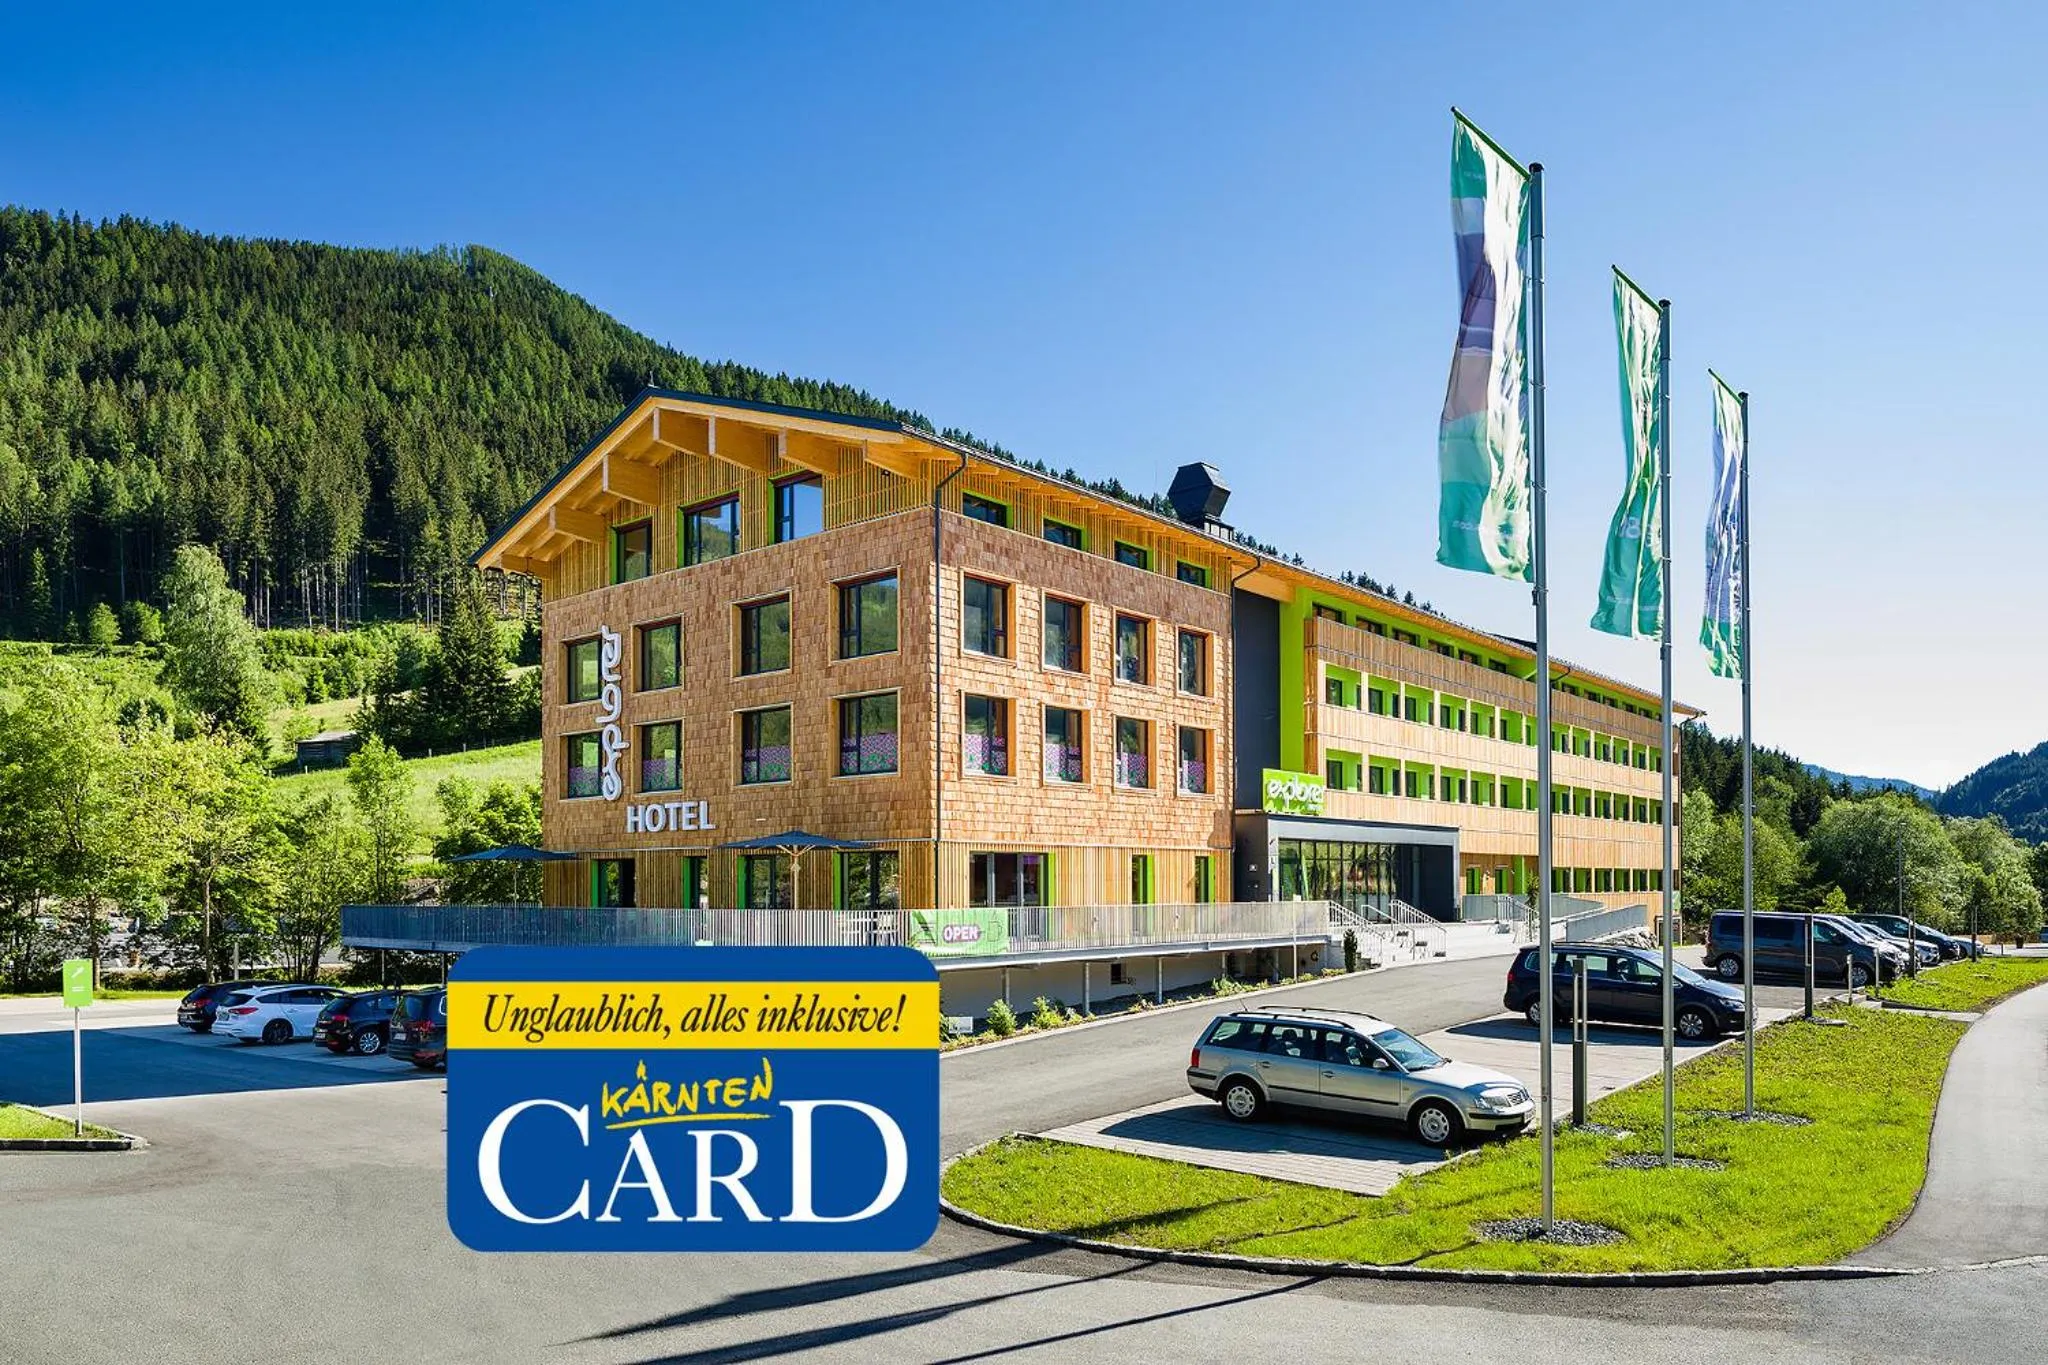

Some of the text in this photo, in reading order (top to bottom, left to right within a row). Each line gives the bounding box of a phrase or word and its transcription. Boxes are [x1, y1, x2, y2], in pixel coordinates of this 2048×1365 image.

[595, 624, 631, 801] explorer
[626, 800, 717, 833] HOTEL
[943, 925, 979, 941] OPEN
